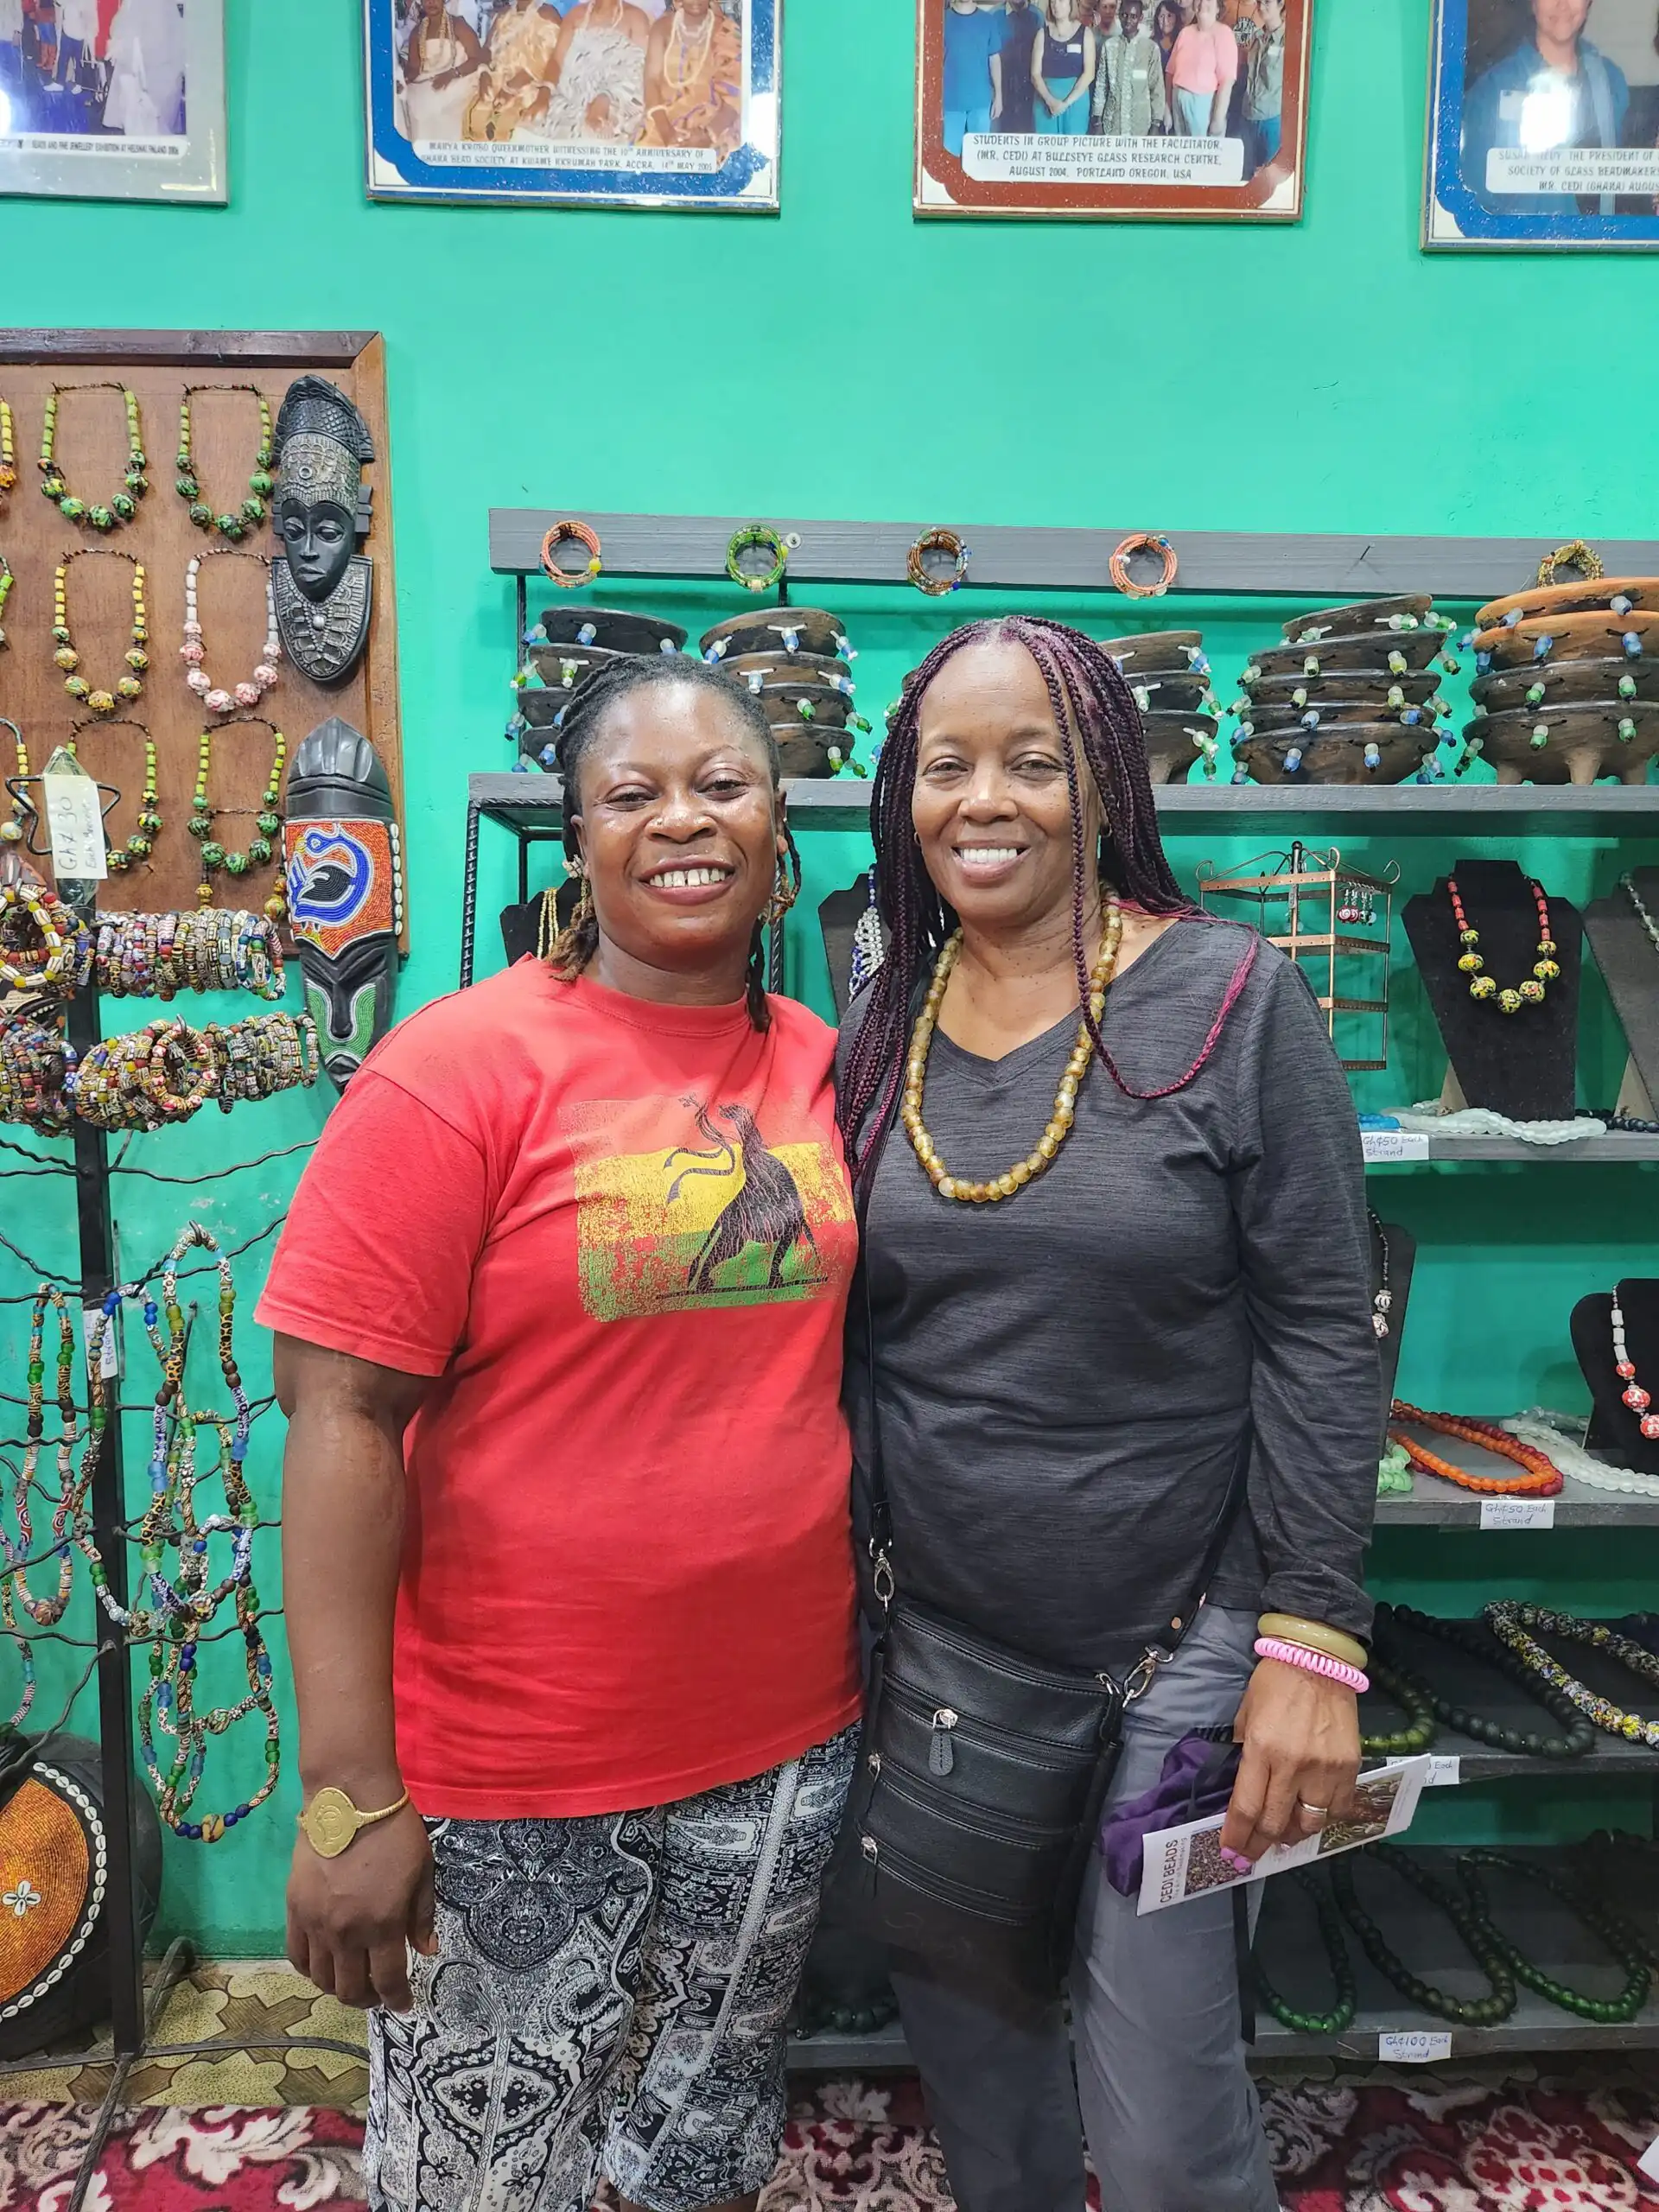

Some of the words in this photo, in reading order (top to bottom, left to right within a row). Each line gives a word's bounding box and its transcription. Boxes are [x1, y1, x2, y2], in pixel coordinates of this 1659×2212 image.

[973, 135, 1020, 145] STUDENTS
[1024, 136, 1033, 145] IN
[1038, 137, 1069, 147] GROUP
[1073, 137, 1111, 148] PICTURE
[1116, 137, 1138, 149] WITH
[1142, 138, 1158, 149] THE
[553, 145, 601, 156] WITNESSING
[605, 147, 617, 156] THE
[636, 148, 693, 157] ANNIVERSARY
[695, 149, 704, 159] OF
[1003, 150, 1028, 161] CEDI)
[1032, 151, 1042, 161] AT
[1046, 151, 1093, 162] BULLSEYE
[1097, 152, 1127, 163] GLASS
[1132, 154, 1180, 164] RESEARCH
[1588, 150, 1639, 161] PRESIDENT
[1643, 151, 1654, 161] OF
[475, 156, 505, 164] SOCIETY
[510, 156, 518, 165] AT
[677, 162, 695, 171] MAY
[1009, 166, 1046, 176] AUGUST
[1077, 167, 1125, 178] PORTLAND
[1173, 168, 1192, 180] USA
[1508, 166, 1547, 176] SOCIETY
[1550, 166, 1560, 176] OF
[1564, 166, 1594, 176] GLASS
[1561, 181, 1583, 191] CEDI
[1586, 181, 1624, 192] (GHANA)
[57, 796, 78, 823] 30
[1365, 1146, 1403, 1156] Strand
[1493, 1514, 1534, 1526] Strand
[1163, 1839, 1179, 1878] BEADS
[1160, 1878, 1174, 1903] CEDI
